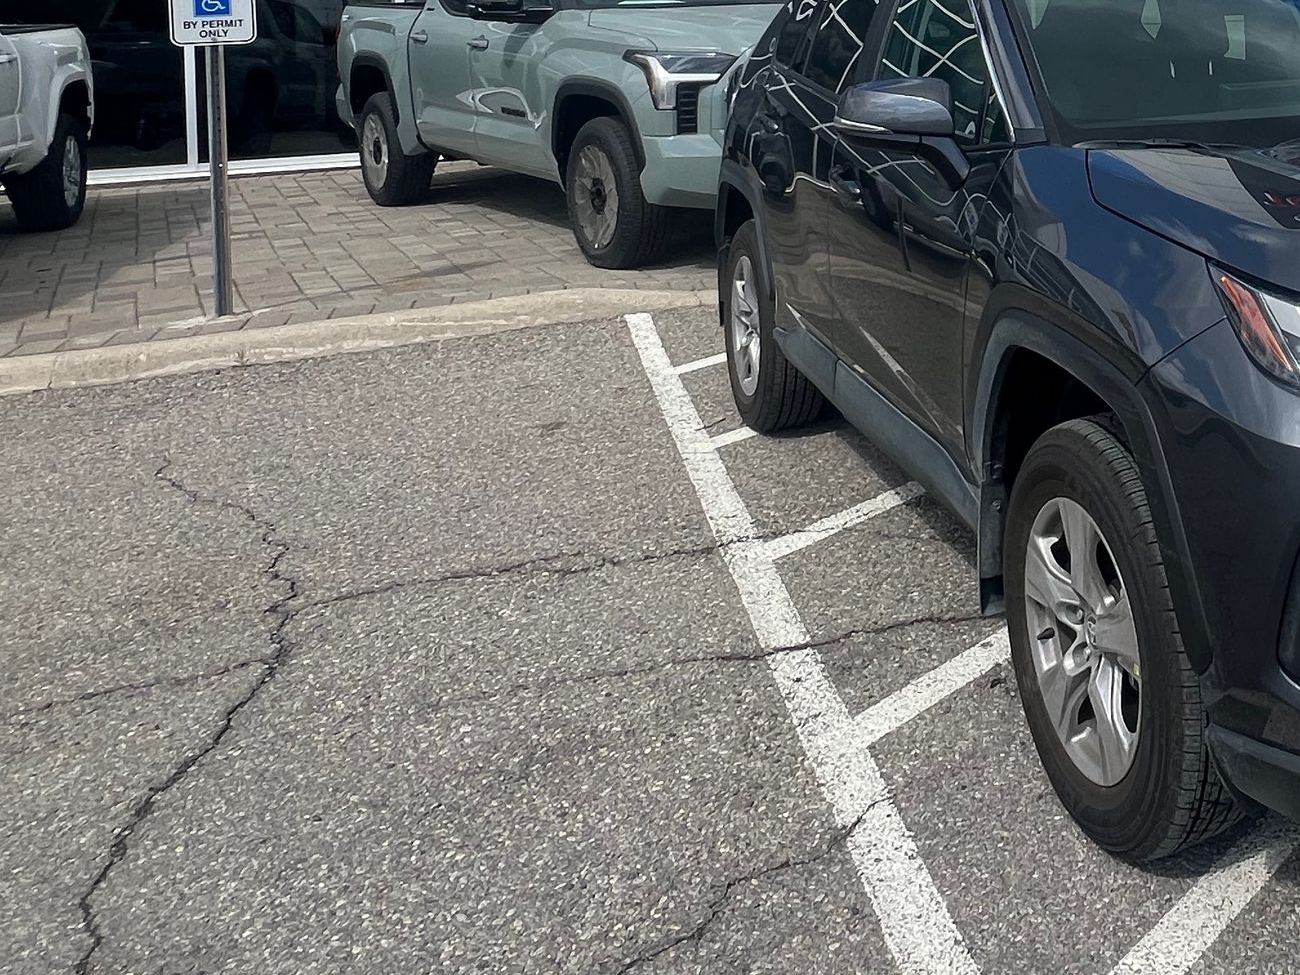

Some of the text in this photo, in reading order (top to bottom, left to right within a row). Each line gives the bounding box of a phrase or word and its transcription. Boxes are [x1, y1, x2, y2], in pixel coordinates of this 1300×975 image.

[183, 19, 244, 29] BY PERMIT
[199, 29, 229, 38] ONLY
